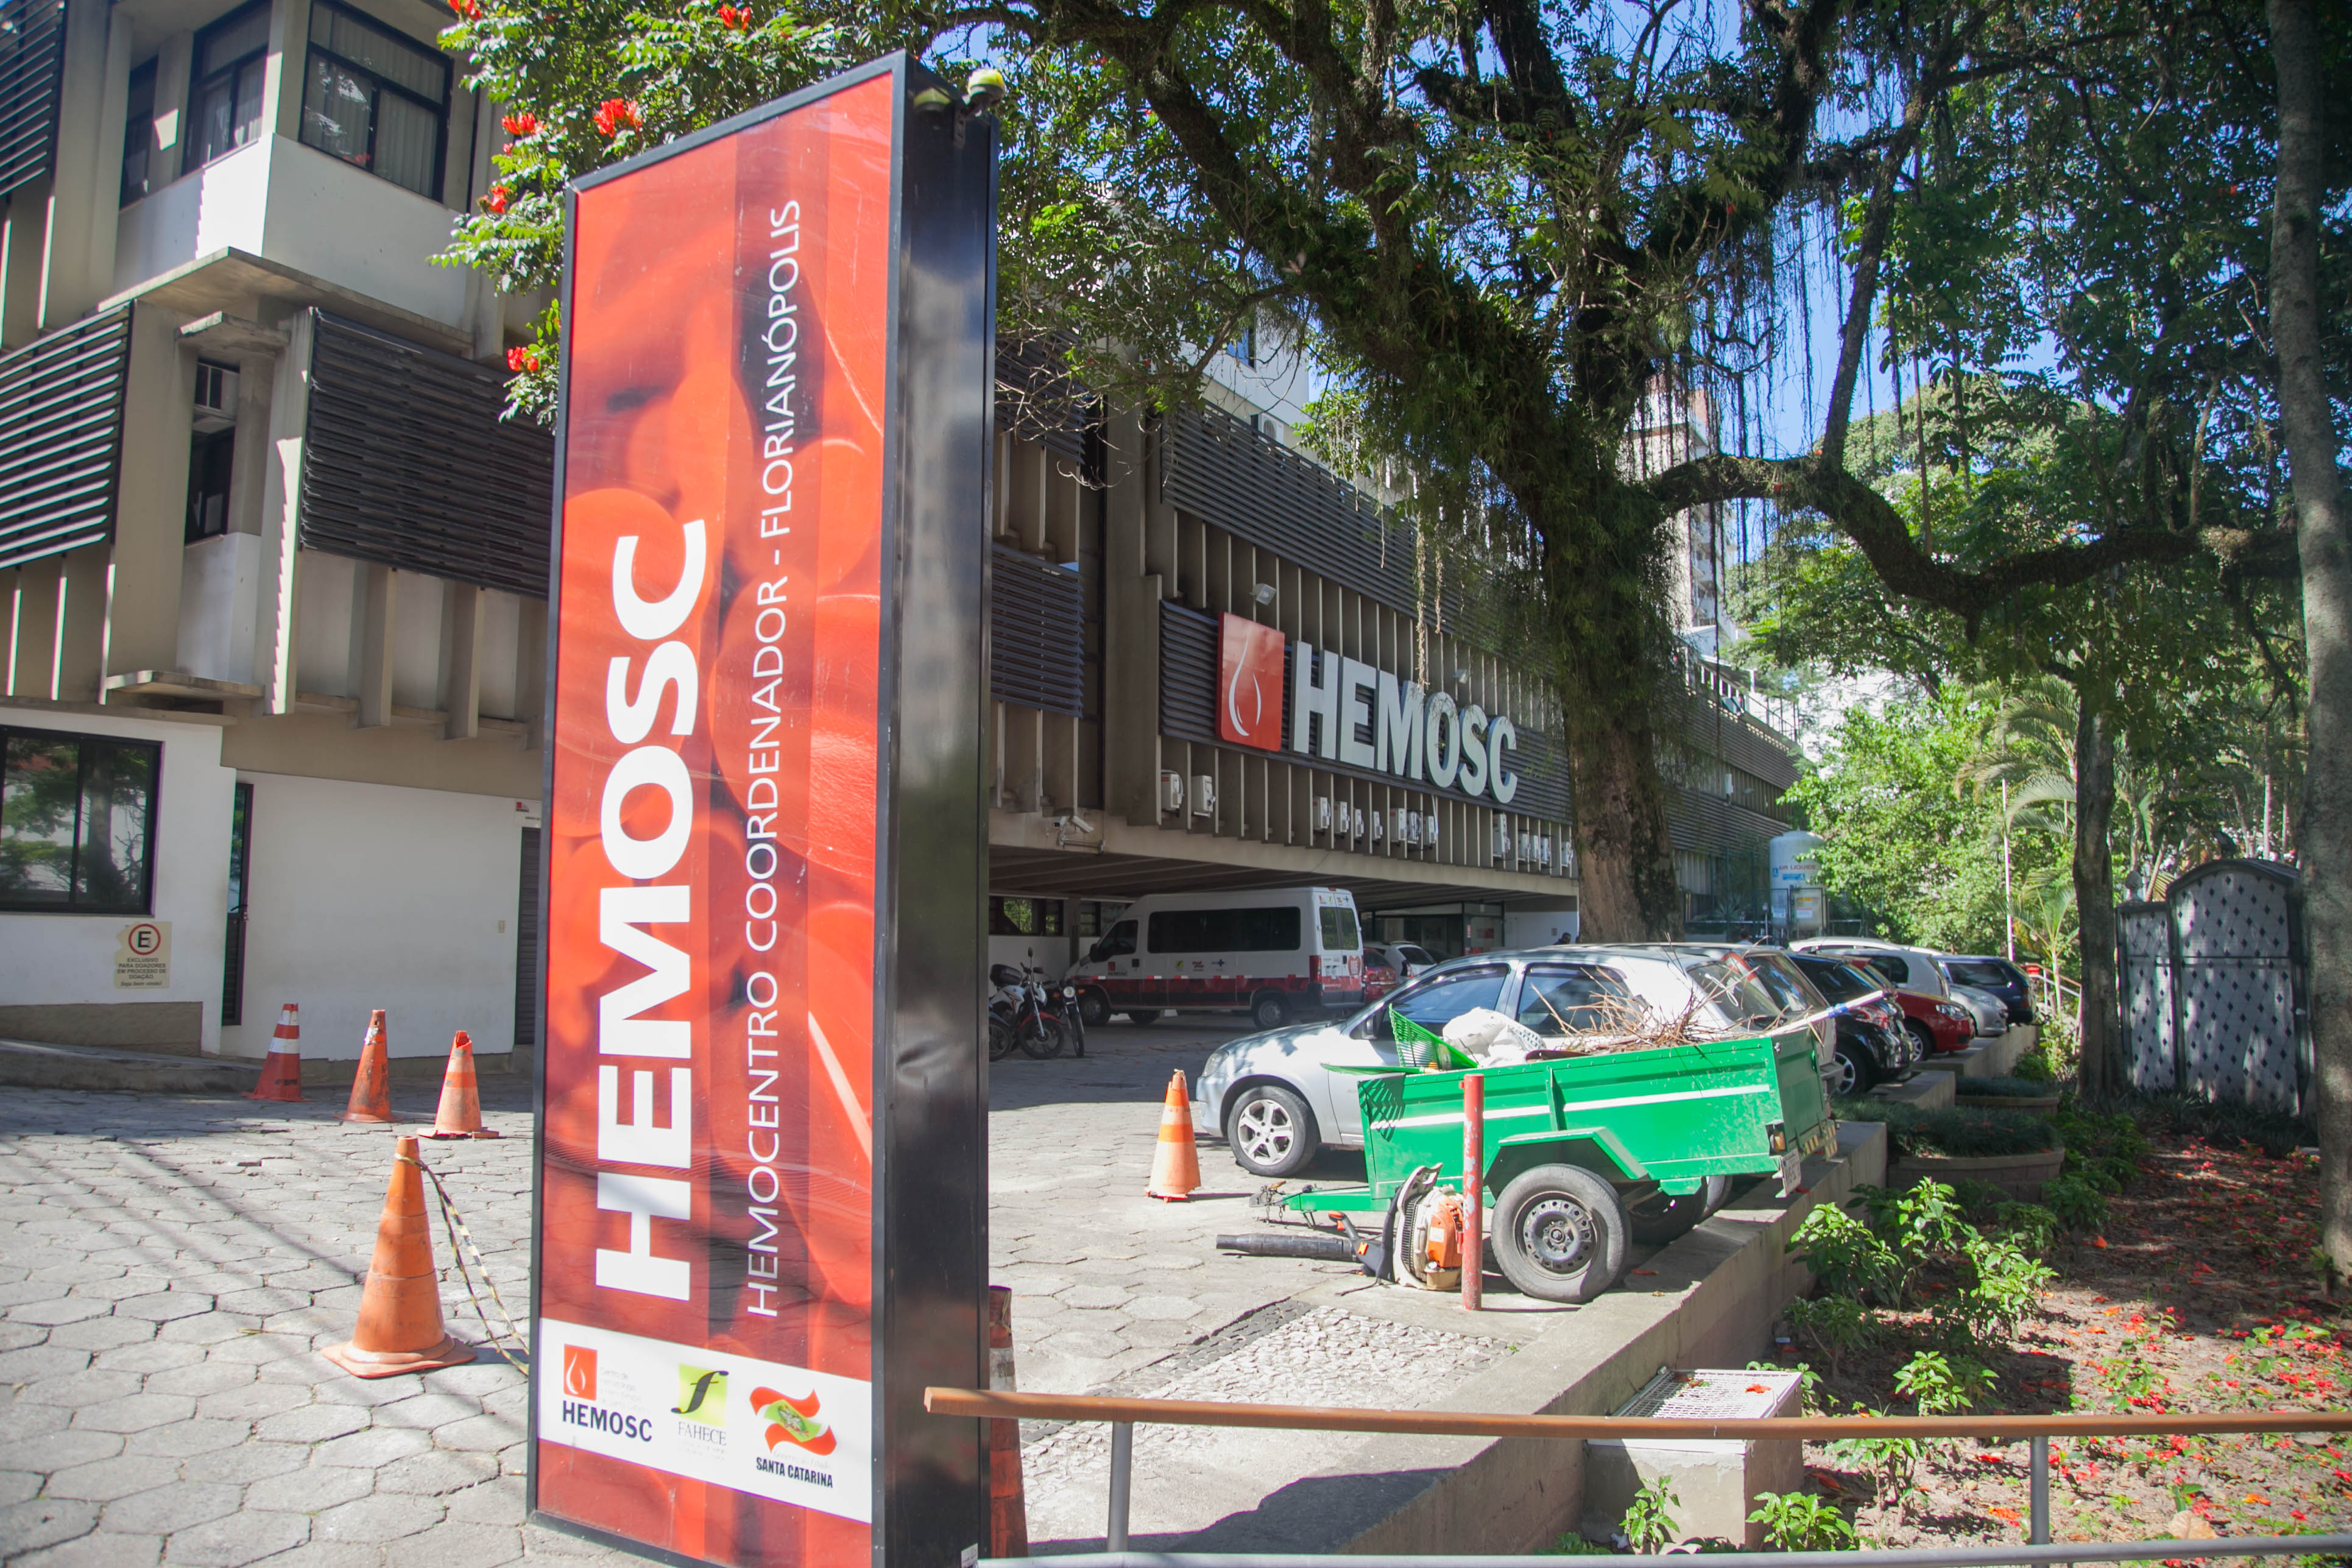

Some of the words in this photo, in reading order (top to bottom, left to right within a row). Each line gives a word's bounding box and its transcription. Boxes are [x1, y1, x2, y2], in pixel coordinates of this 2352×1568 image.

[760, 199, 800, 539] FLORIANÓPOLIS
[746, 576, 788, 952] COORDENADOR
[1290, 640, 1518, 804] HEMOSC
[137, 931, 151, 948] E
[596, 519, 707, 1301] HEMOSC
[746, 971, 779, 1317] HEMOCENTRO
[562, 1400, 652, 1442] HEMOSC
[677, 1421, 727, 1446] FAHECE
[755, 1457, 786, 1477] SANTA
[787, 1464, 833, 1488] CATARINA
